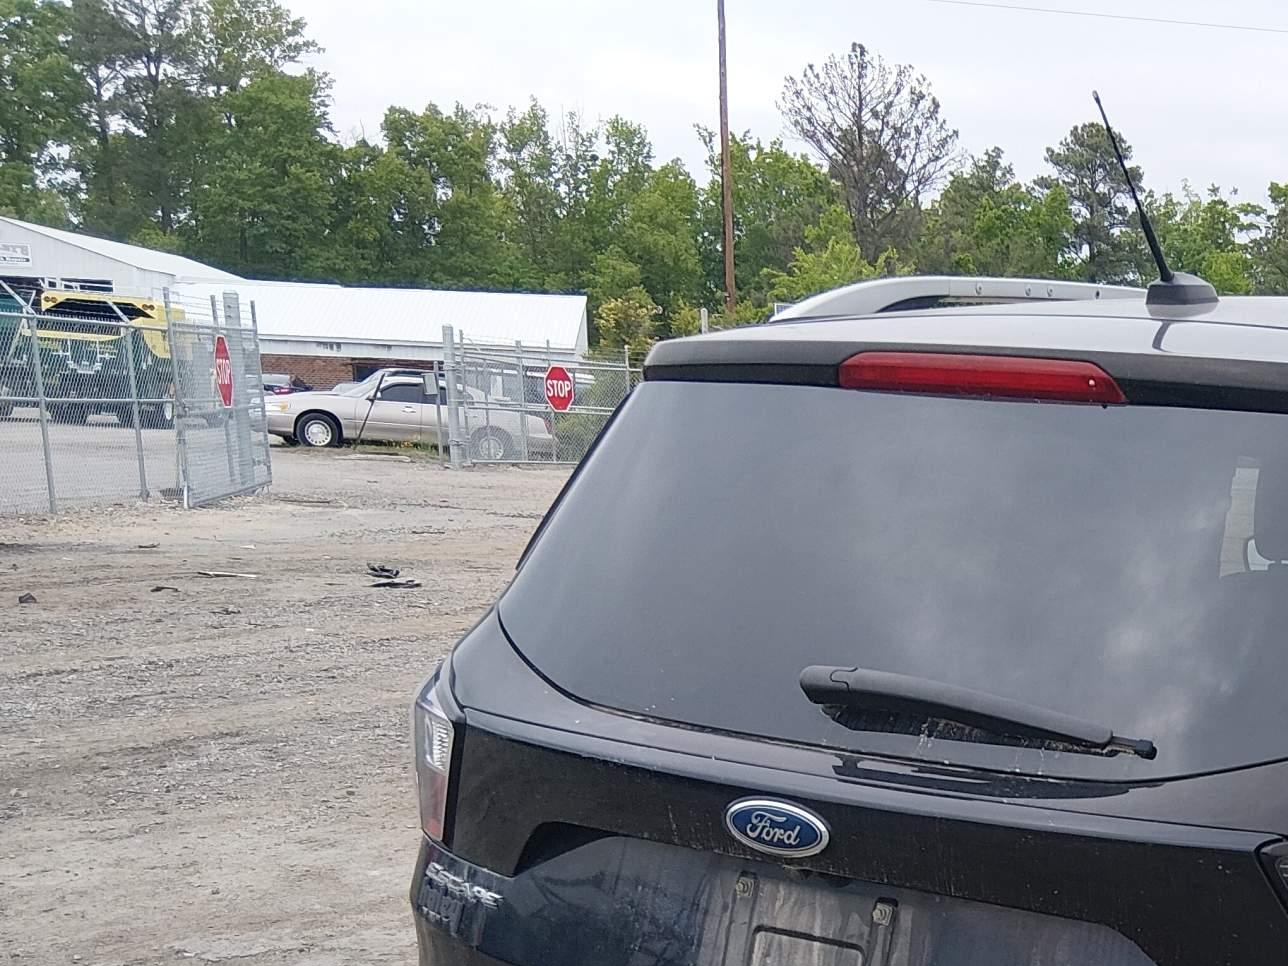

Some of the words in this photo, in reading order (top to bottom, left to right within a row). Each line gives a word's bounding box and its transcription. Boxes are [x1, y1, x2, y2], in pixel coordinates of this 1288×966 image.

[216, 358, 231, 385] STOP
[546, 379, 571, 398] STOP
[746, 811, 800, 846] Ford
[426, 862, 504, 910] ESCAPE
